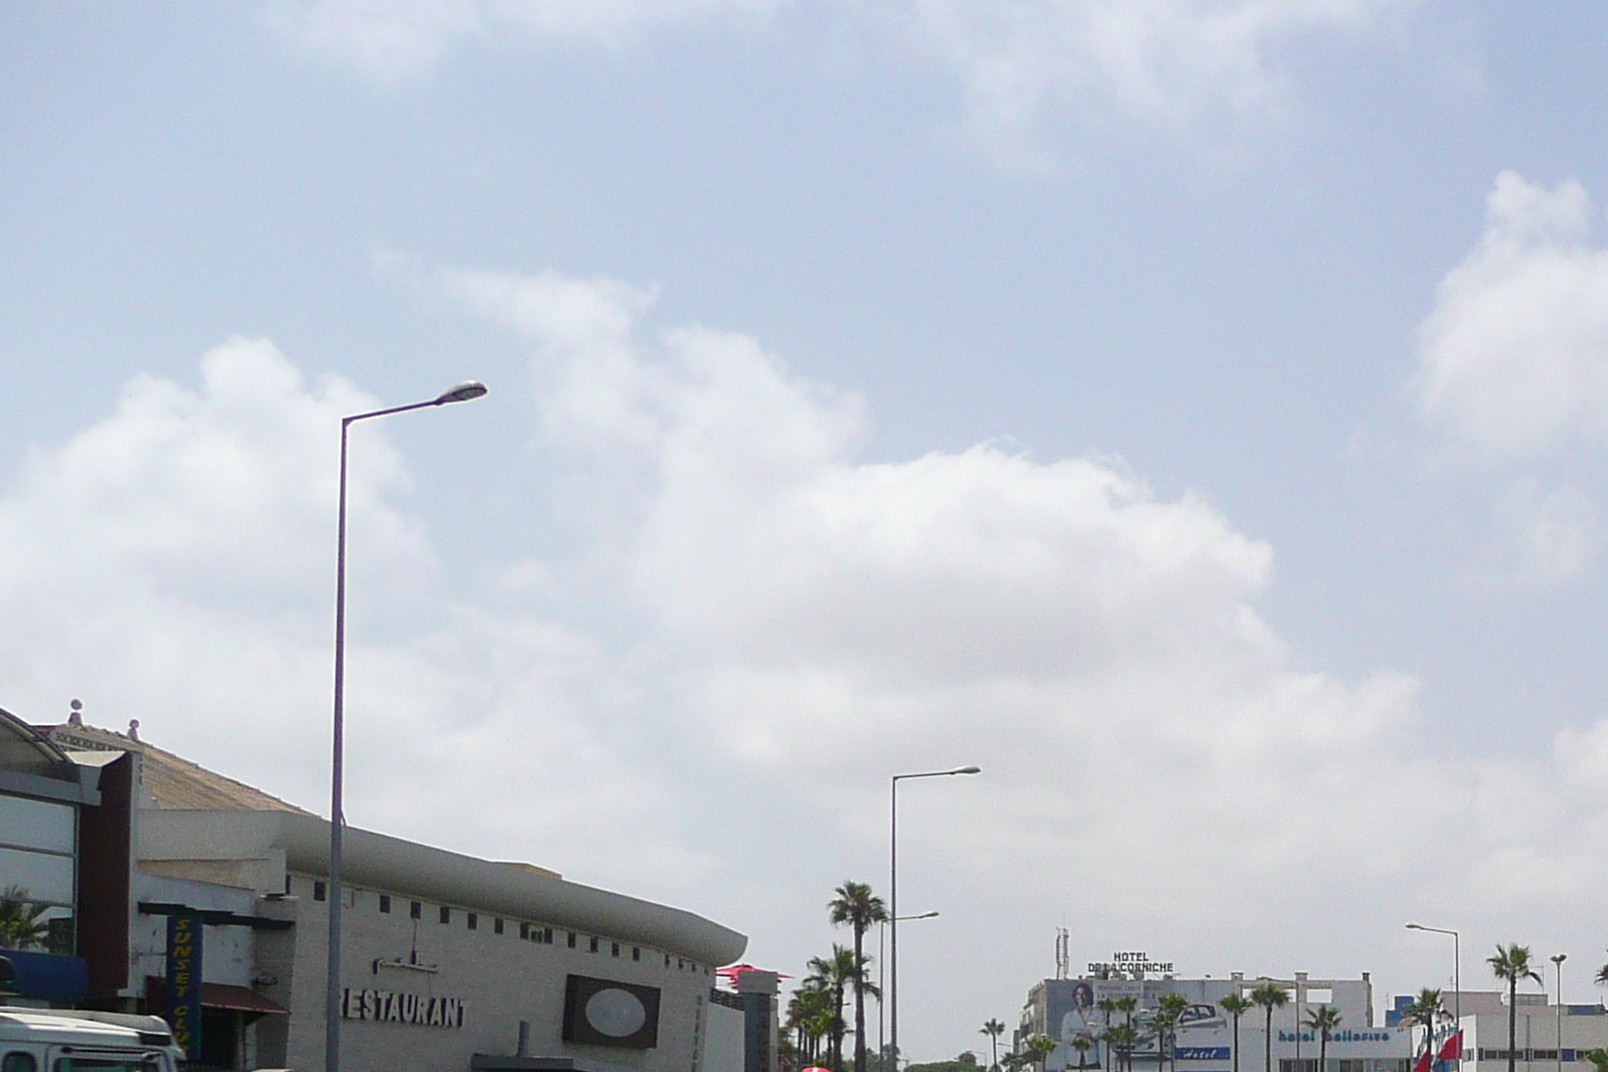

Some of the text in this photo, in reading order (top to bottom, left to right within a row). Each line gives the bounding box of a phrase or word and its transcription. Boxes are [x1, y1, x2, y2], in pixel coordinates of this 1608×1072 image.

[173, 918, 192, 998] SUNSET
[1113, 952, 1149, 962] HOTEL
[1120, 962, 1173, 973] CORNICHE
[173, 1005, 191, 1051] CLU
